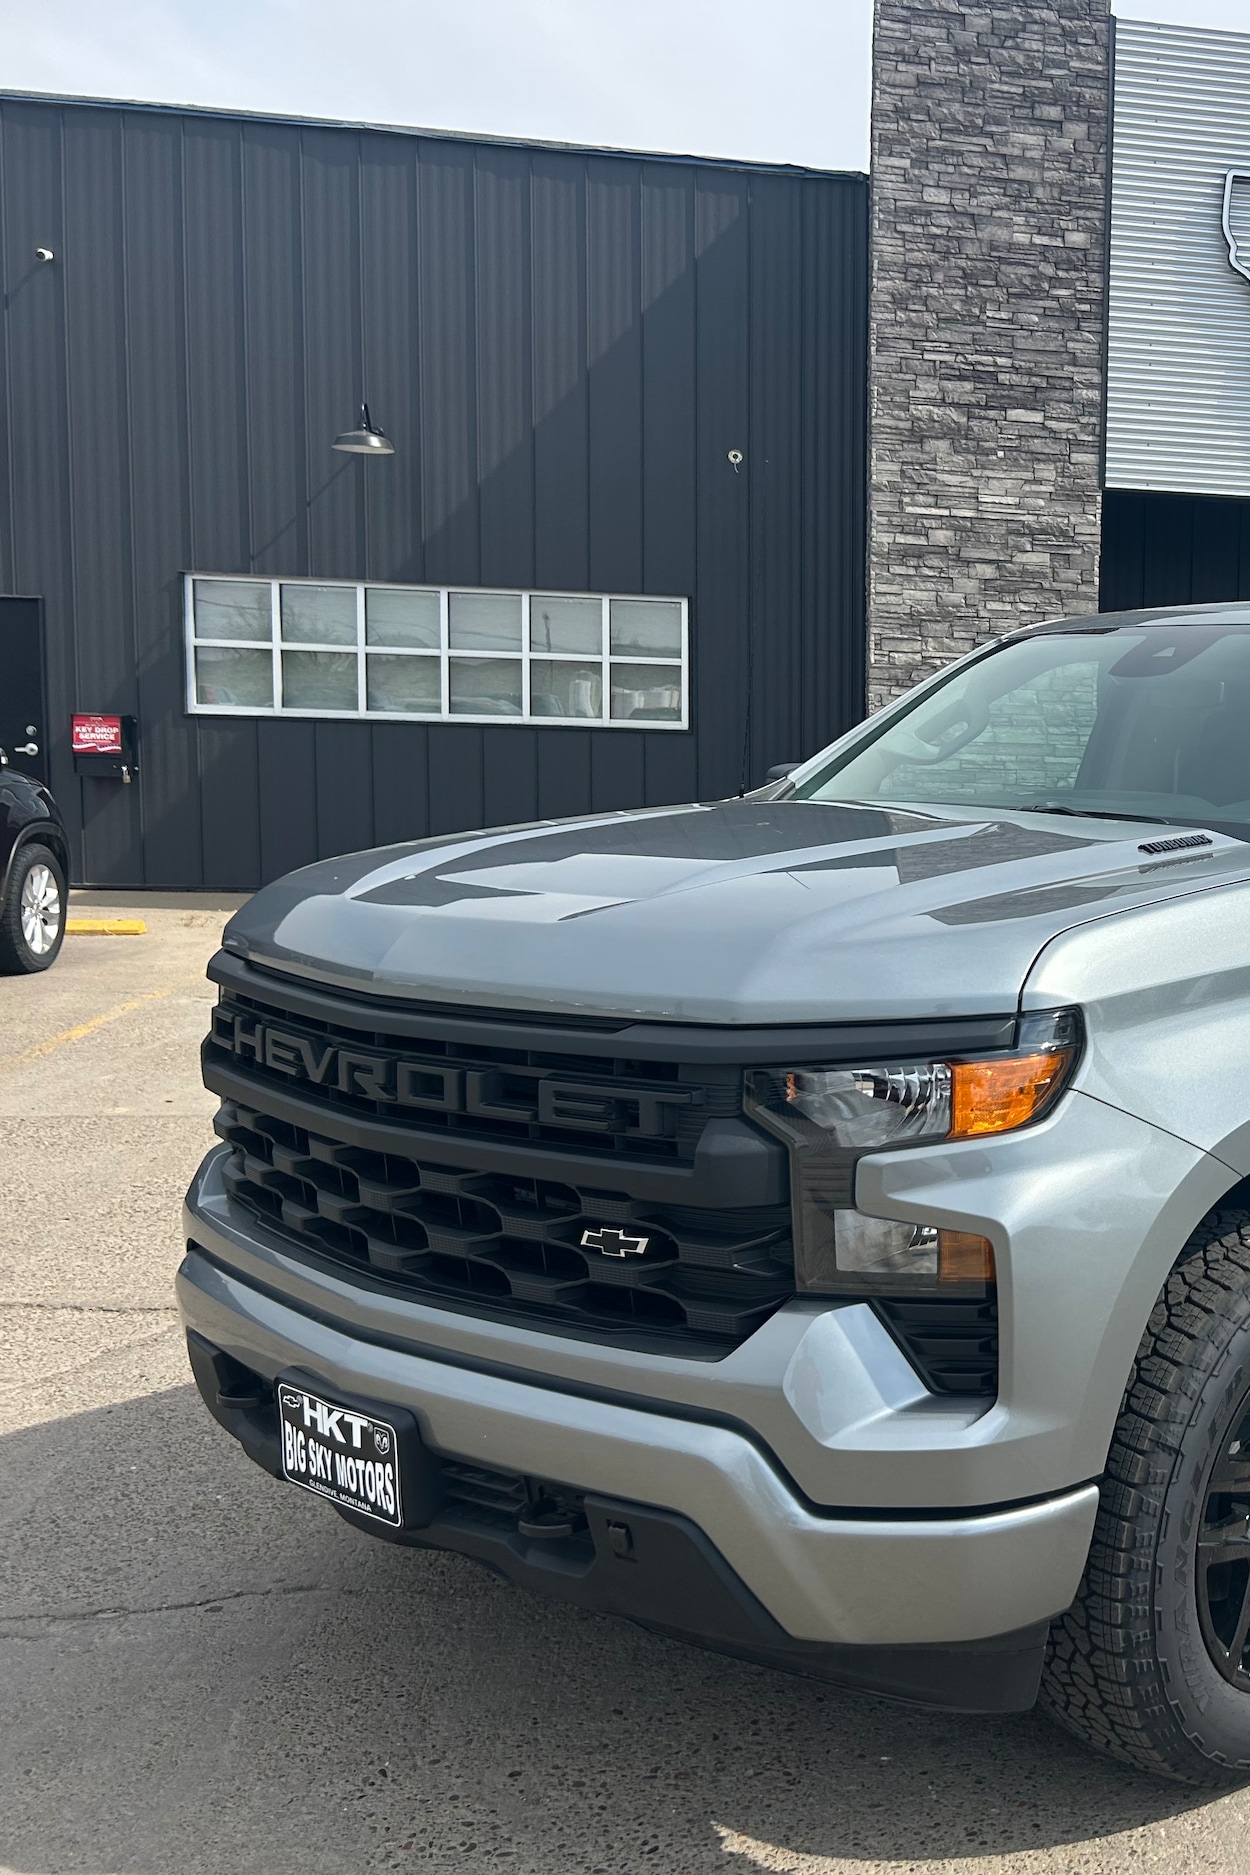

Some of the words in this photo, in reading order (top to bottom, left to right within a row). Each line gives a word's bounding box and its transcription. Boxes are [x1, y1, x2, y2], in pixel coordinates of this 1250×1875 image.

[78, 732, 116, 741] SERVICE
[94, 726, 120, 734] DROP
[212, 1006, 704, 1137] CHEVROLET
[302, 1394, 368, 1449] HKT
[284, 1420, 307, 1473] BIG
[308, 1437, 332, 1482] SKY
[334, 1452, 395, 1515] MOTORS
[339, 1492, 372, 1512] MONTANA
